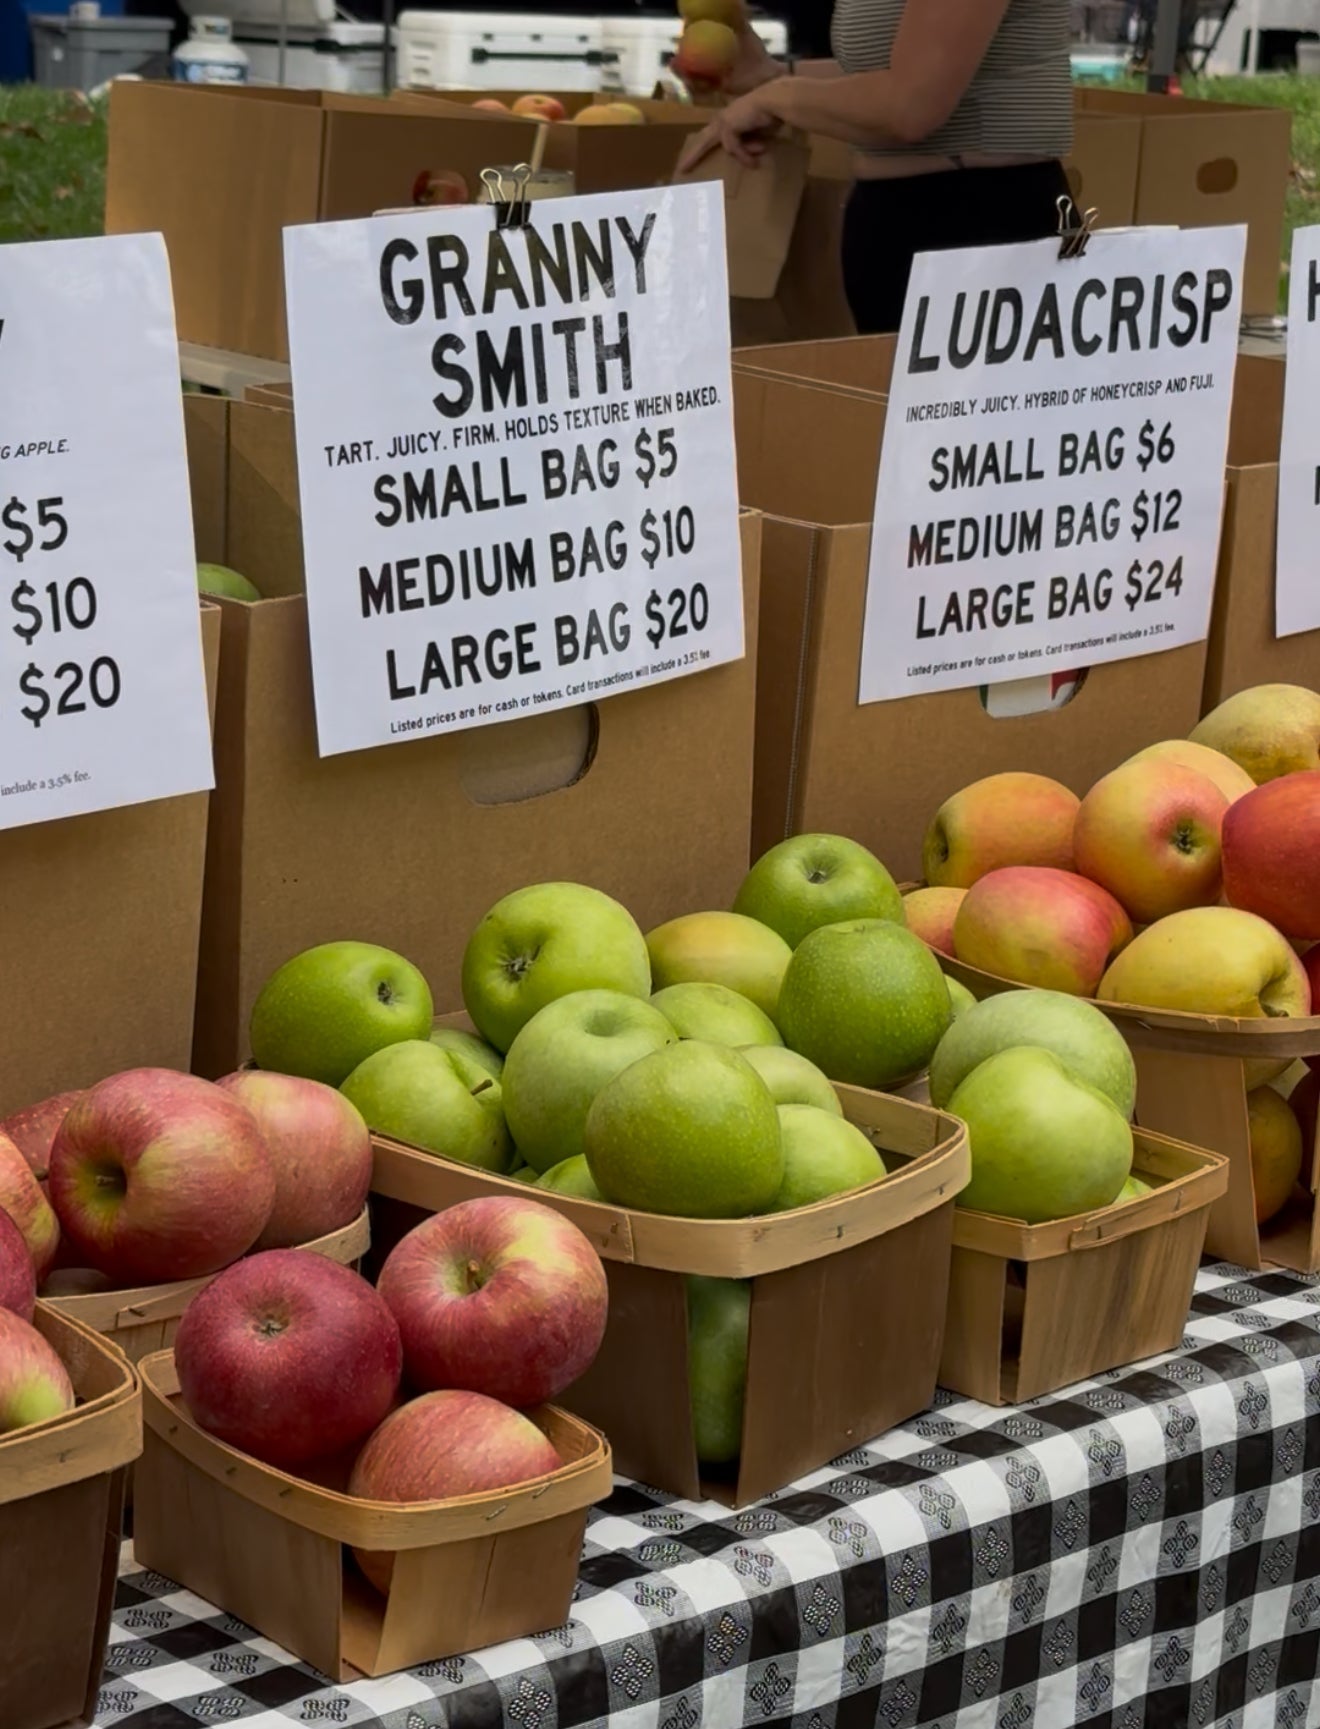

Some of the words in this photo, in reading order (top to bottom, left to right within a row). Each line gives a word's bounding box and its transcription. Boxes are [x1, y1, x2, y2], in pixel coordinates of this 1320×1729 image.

[379, 212, 657, 326] GRANNY
[907, 267, 1233, 374] LUDACRISP
[431, 311, 632, 419] SMITH
[905, 398, 978, 423] INCREDIBLY
[980, 394, 1021, 415] JUICY.
[1024, 389, 1070, 409] HYBRID
[1071, 386, 1088, 405] OF
[1090, 379, 1163, 402] HONEYCRISP
[1164, 376, 1188, 394] AND
[1189, 373, 1215, 391] FUJI.
[13, 438, 70, 459] APPLE.
[323, 439, 380, 468] TART.
[386, 430, 448, 459] JUICY.
[452, 422, 500, 449] FIRM.
[504, 412, 559, 441] HOLDS
[562, 401, 631, 431] TEXTURE
[633, 394, 673, 419] WHEN
[675, 385, 721, 412] BAKED.
[928, 437, 1045, 493] SMALL
[1058, 426, 1125, 477] BAG
[1136, 418, 1176, 473] $6
[373, 456, 528, 528] SMALL
[540, 438, 621, 500] BAG
[634, 426, 678, 490] $5
[1, 495, 69, 563] $5
[358, 537, 537, 619] MEDIUM
[549, 519, 628, 583] BAG
[640, 505, 695, 570] $10
[907, 508, 1044, 569] MEDIUM
[1054, 497, 1121, 549] BAG
[1130, 488, 1183, 543] $12
[10, 576, 97, 646] $10
[915, 580, 1036, 640] LARGE
[1047, 568, 1113, 620] BAG
[1124, 555, 1183, 613] $24
[385, 622, 542, 701] LARGE
[554, 601, 631, 667] BAG
[645, 582, 709, 650] $20
[906, 663, 933, 677] Listed
[932, 661, 958, 676] prices
[959, 659, 973, 669] are
[974, 656, 987, 667] for
[987, 653, 1007, 665] cash
[1006, 653, 1016, 662] or
[1045, 643, 1063, 656] Card
[1063, 637, 1105, 652] transactions
[1105, 633, 1118, 644] will
[1118, 629, 1143, 641] include
[1143, 629, 1148, 637] a
[19, 655, 121, 729] $20
[390, 716, 424, 735] Listed
[425, 711, 457, 729] prices
[458, 707, 476, 720] are
[477, 703, 493, 716] for
[495, 697, 519, 713] cash
[520, 696, 531, 708] or
[565, 681, 586, 697] Card
[587, 671, 634, 691] transactions
[650, 658, 676, 675] include
[677, 657, 683, 667] a
[39, 780, 46, 789] a
